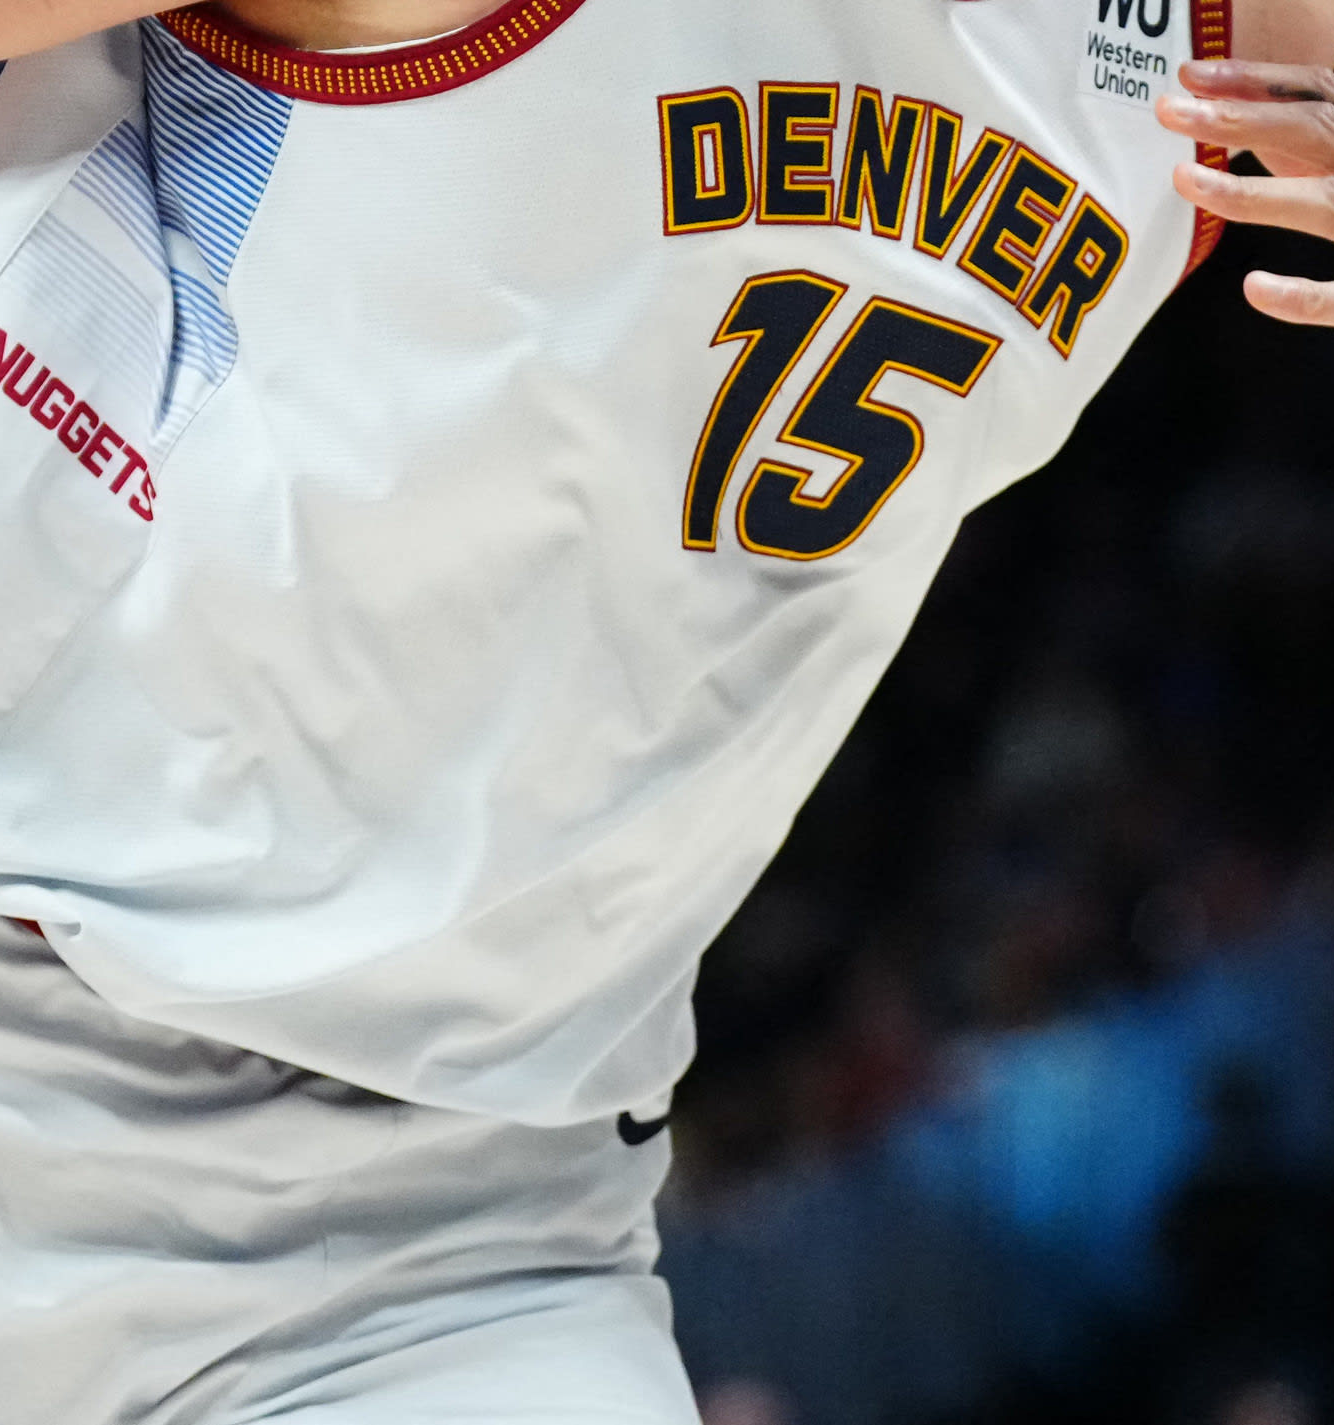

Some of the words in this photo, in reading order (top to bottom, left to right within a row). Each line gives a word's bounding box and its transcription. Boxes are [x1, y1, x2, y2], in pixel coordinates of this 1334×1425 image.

[1087, 30, 1167, 75] Western
[1094, 63, 1150, 101] Union
[656, 80, 1130, 358] DENVER
[682, 268, 1005, 563] 15
